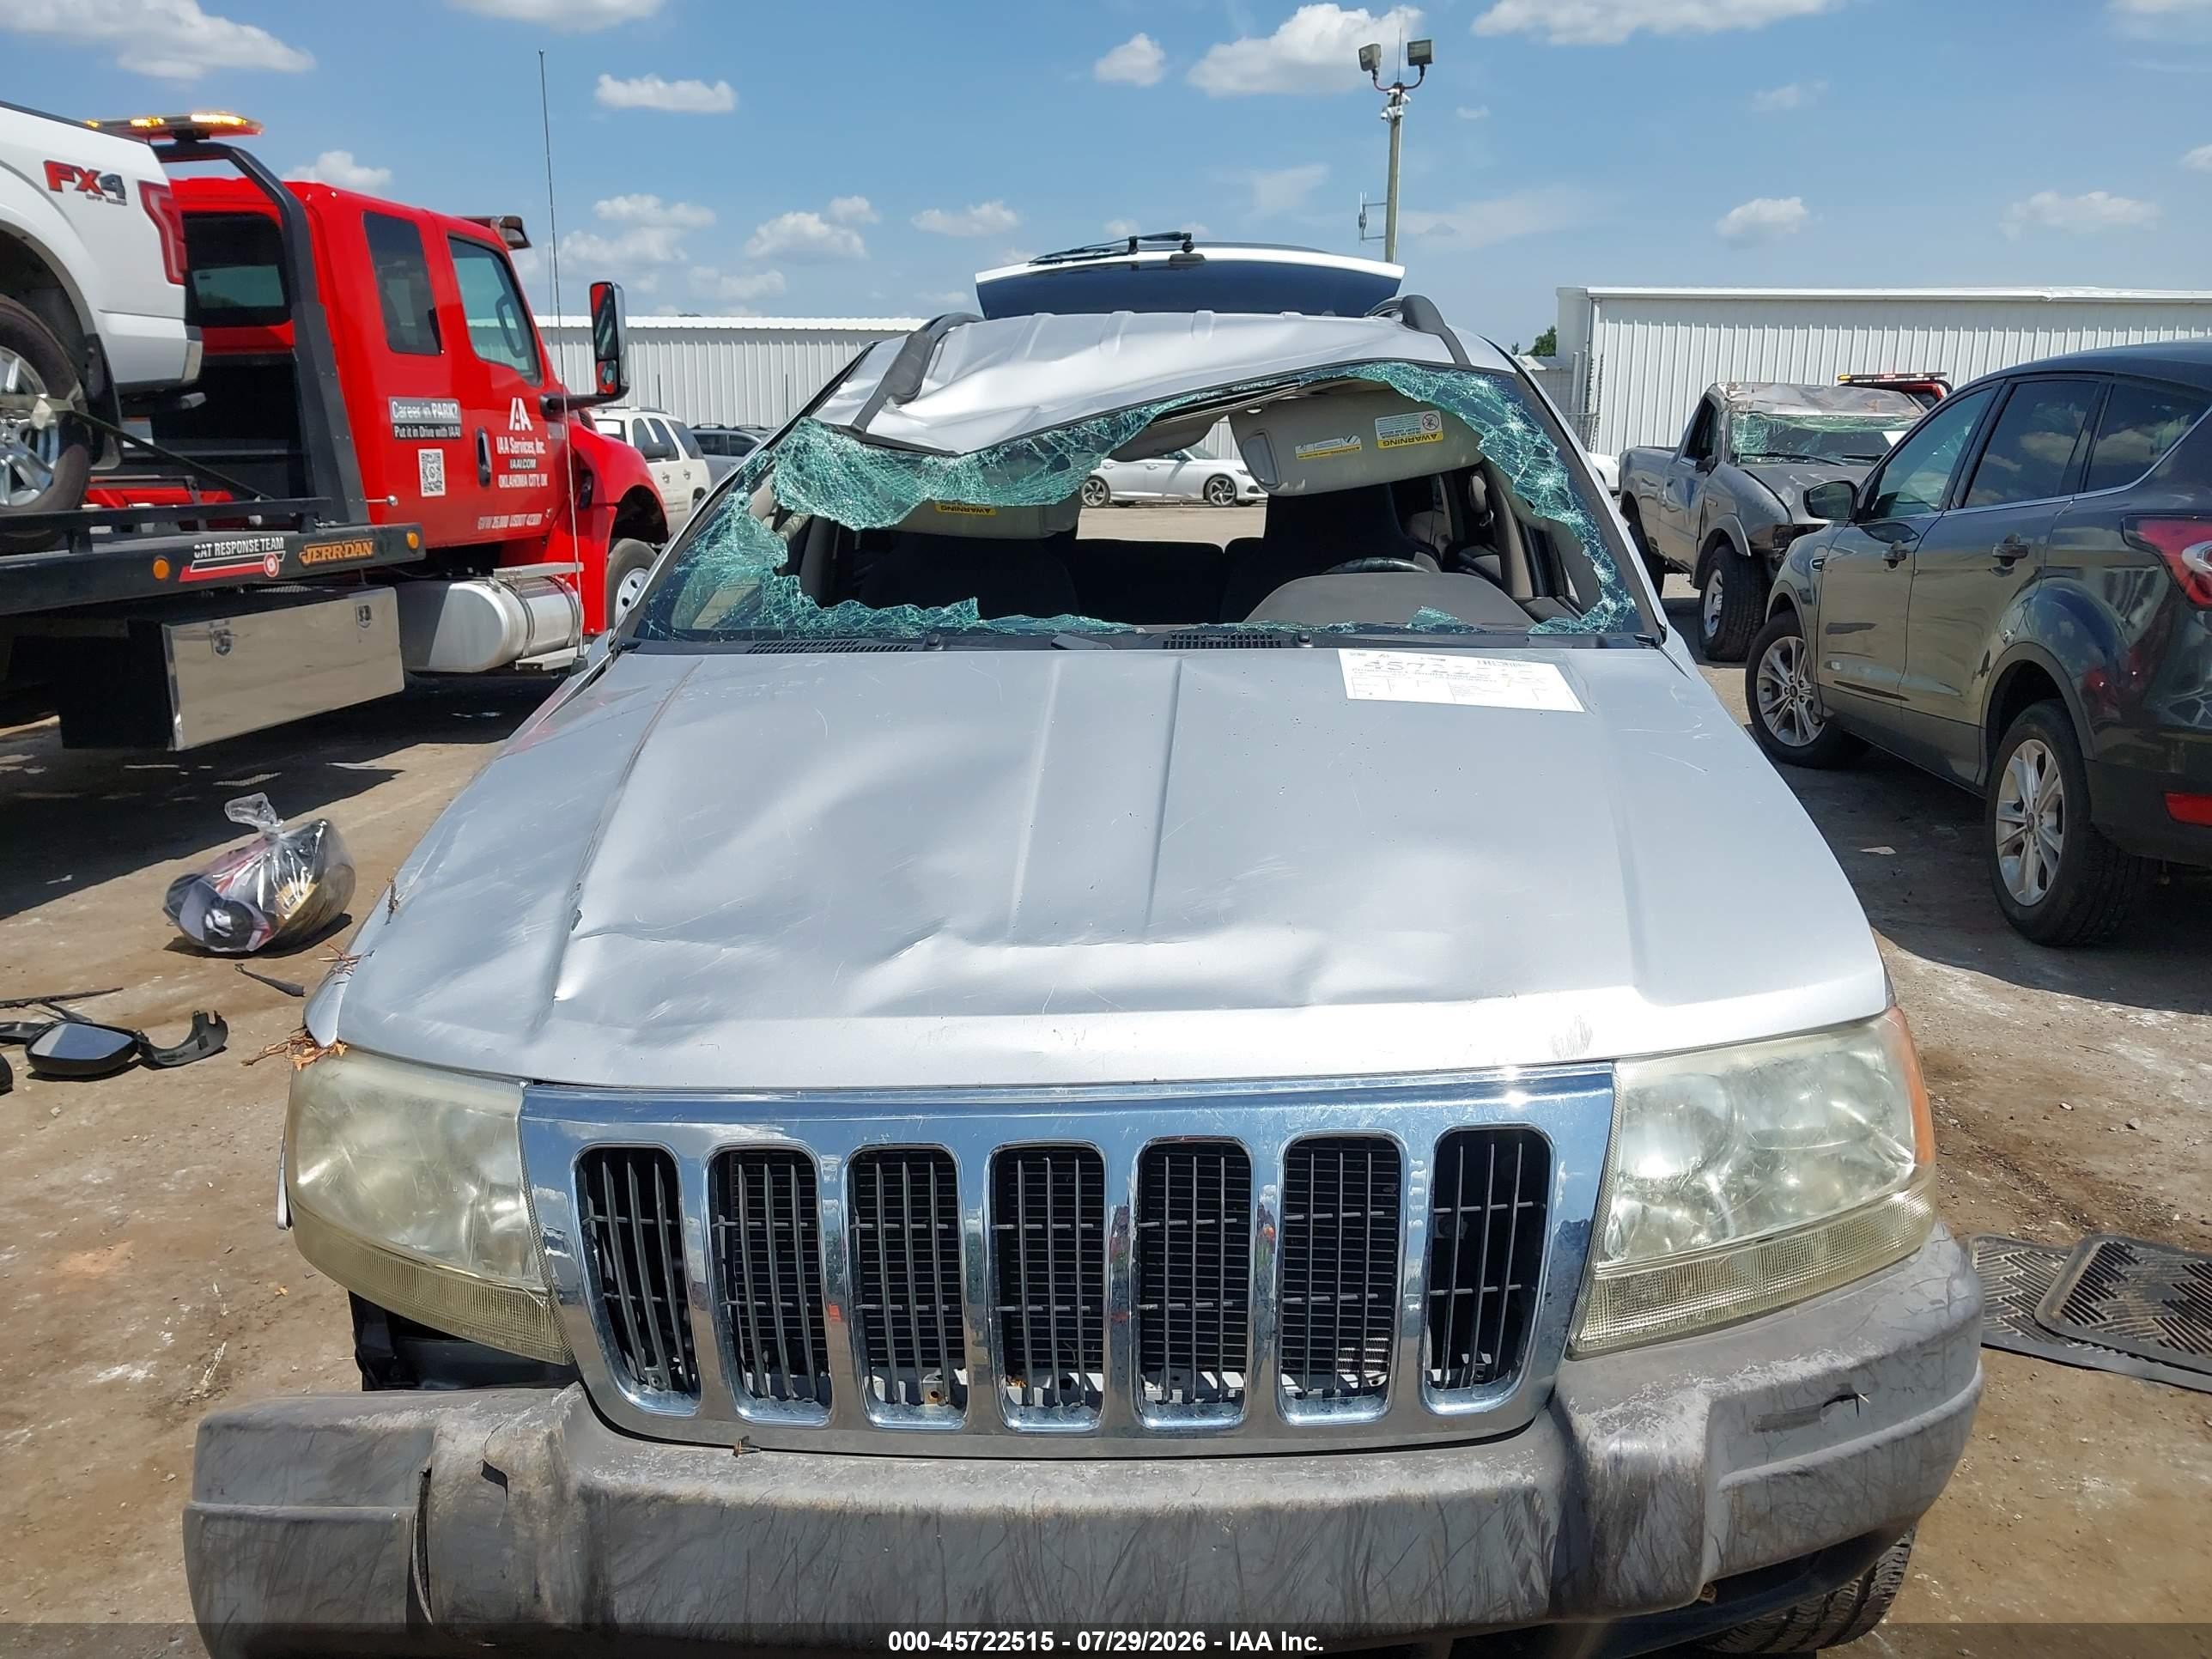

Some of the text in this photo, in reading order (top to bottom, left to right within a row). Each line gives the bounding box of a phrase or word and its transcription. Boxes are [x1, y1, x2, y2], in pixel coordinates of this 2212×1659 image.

[43, 160, 126, 199] FX4
[392, 401, 458, 419] Career in PARK?
[394, 426, 406, 438] Put
[1382, 433, 1431, 447] WARNING
[940, 505, 985, 514] WARNING
[194, 537, 284, 559] CAT RESPONSE TEAM
